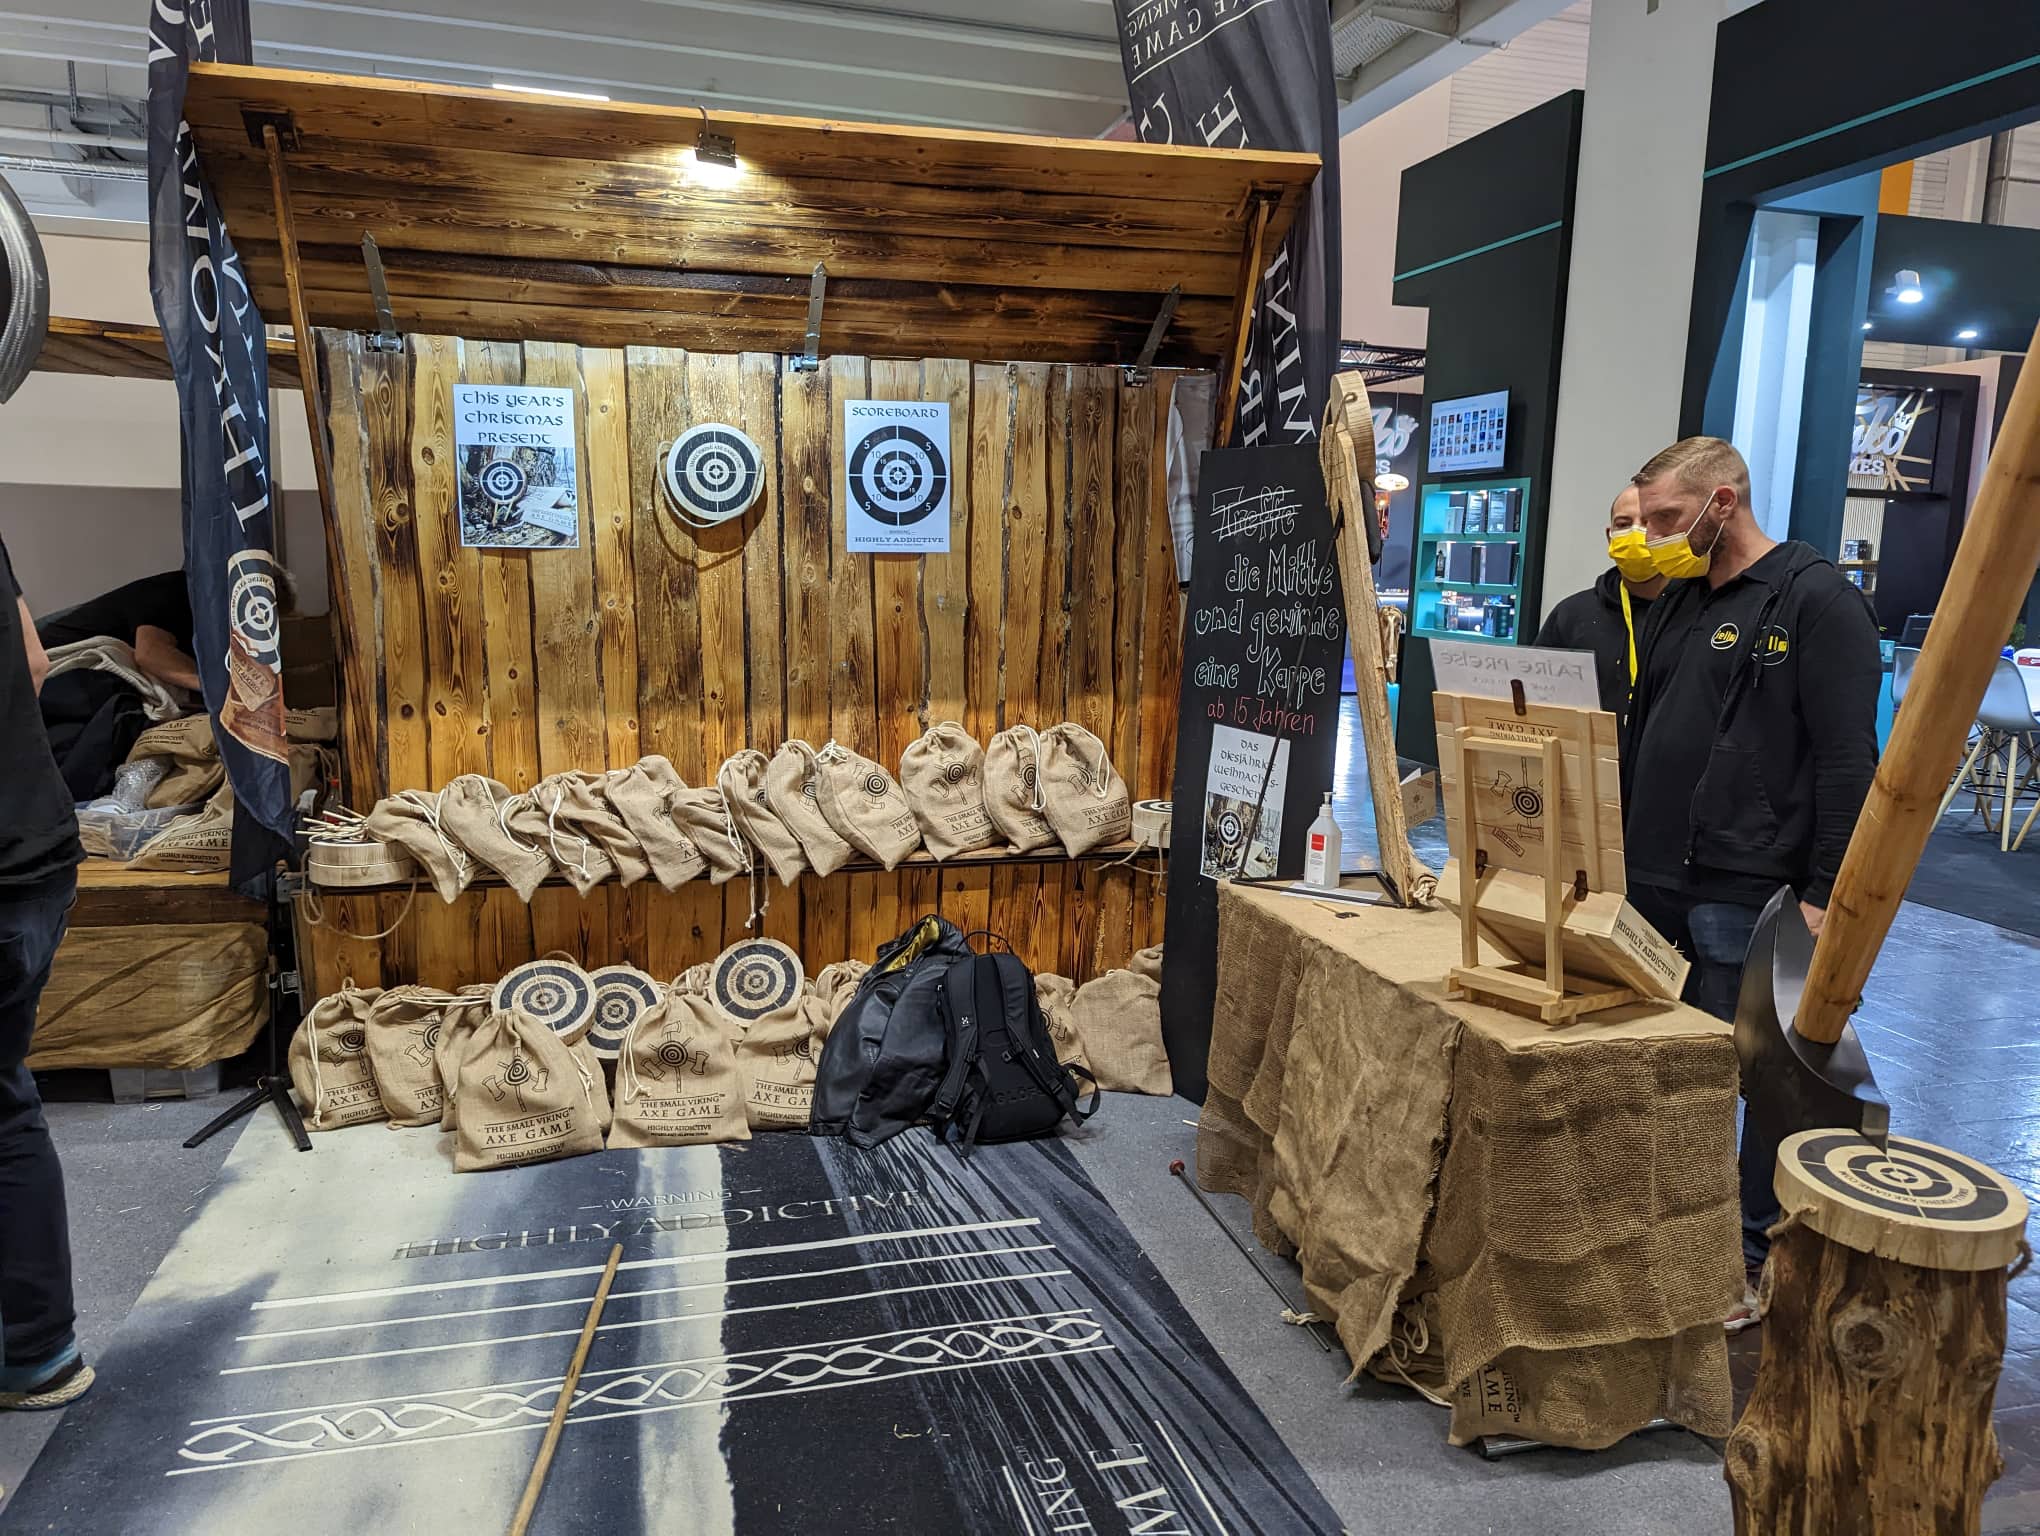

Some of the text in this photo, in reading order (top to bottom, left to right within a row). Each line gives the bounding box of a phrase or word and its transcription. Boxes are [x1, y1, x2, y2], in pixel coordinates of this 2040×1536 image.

[852, 407, 939, 418] SCOREBOARD
[863, 440, 870, 449] 5
[926, 442, 932, 451] 5
[871, 451, 881, 459] 10
[864, 501, 871, 510] 5
[925, 502, 932, 512] 5
[1225, 539, 1334, 597] die Mitte
[1195, 599, 1340, 662] und gewinne
[1195, 646, 1326, 710] eine Kappe
[1208, 696, 1315, 735] ab 15 Jahren
[1488, 720, 1554, 737] AXE GAME
[185, 838, 229, 848] GAME
[1617, 920, 1643, 949] HIGHLY
[1642, 945, 1677, 982] ADDICTIVE
[329, 1094, 360, 1108] AXE
[420, 1098, 443, 1111] AX
[640, 1100, 658, 1109] THE
[659, 1099, 686, 1109] SMALL
[753, 1090, 808, 1106] AXE GA
[639, 1104, 721, 1118] AXE GAME
[485, 1126, 505, 1135] THE
[507, 1120, 535, 1132] SMALL
[486, 1120, 572, 1145] AXE GAME
[496, 1150, 525, 1161] HIGHLY
[609, 1188, 733, 1211] WARNING
[392, 1189, 930, 1261] HIGHLY ADDICTIVE
